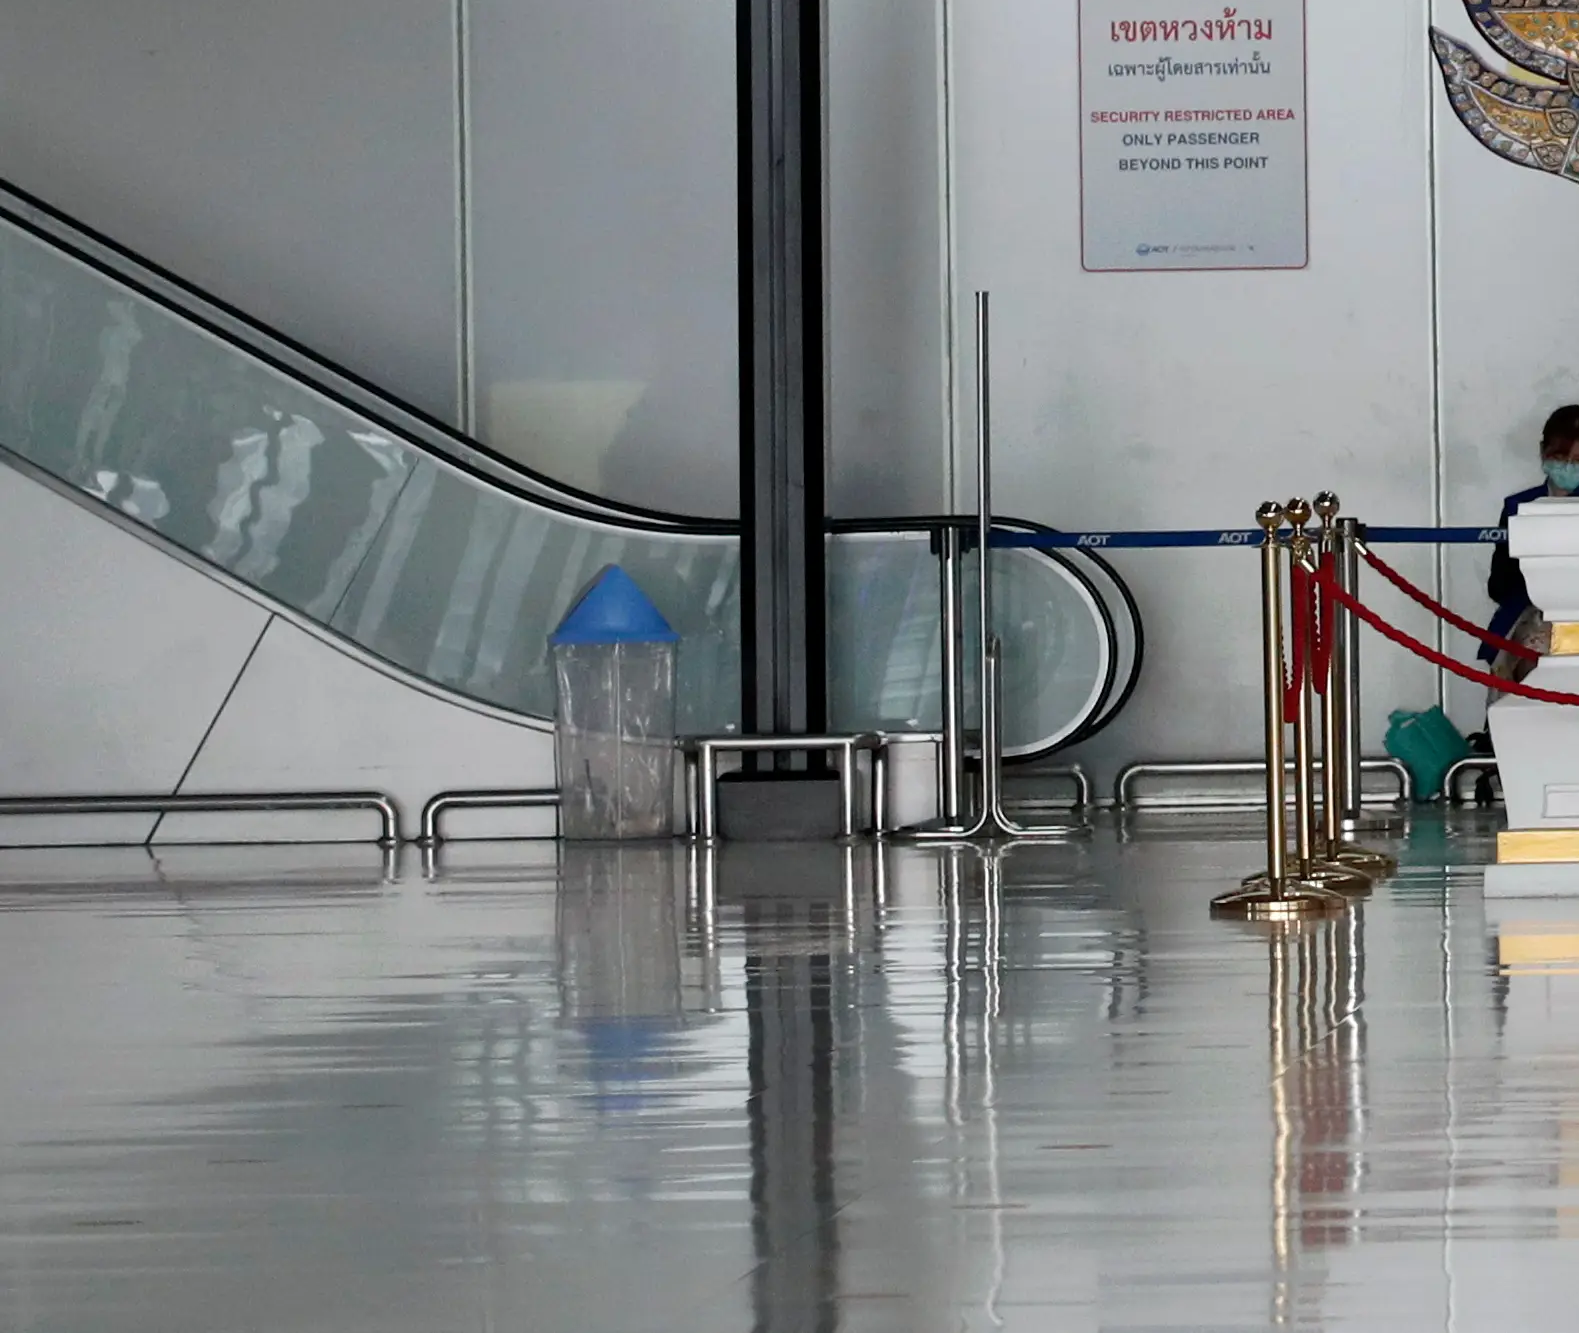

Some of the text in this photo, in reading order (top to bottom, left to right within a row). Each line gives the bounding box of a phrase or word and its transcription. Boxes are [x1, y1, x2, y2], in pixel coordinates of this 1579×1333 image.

[1109, 6, 1274, 43] เขตหวงห้าม
[1108, 51, 1271, 83] เฉพาะผู้โดยสารเท่านั้น
[1090, 108, 1296, 123] SECURITY RESTRICTED AREA
[1122, 132, 1260, 146] ONLY PASSENGER
[1118, 156, 1269, 171] BEYOND THIS POINT
[1077, 534, 1111, 546] AOT
[1218, 531, 1252, 544] AOT
